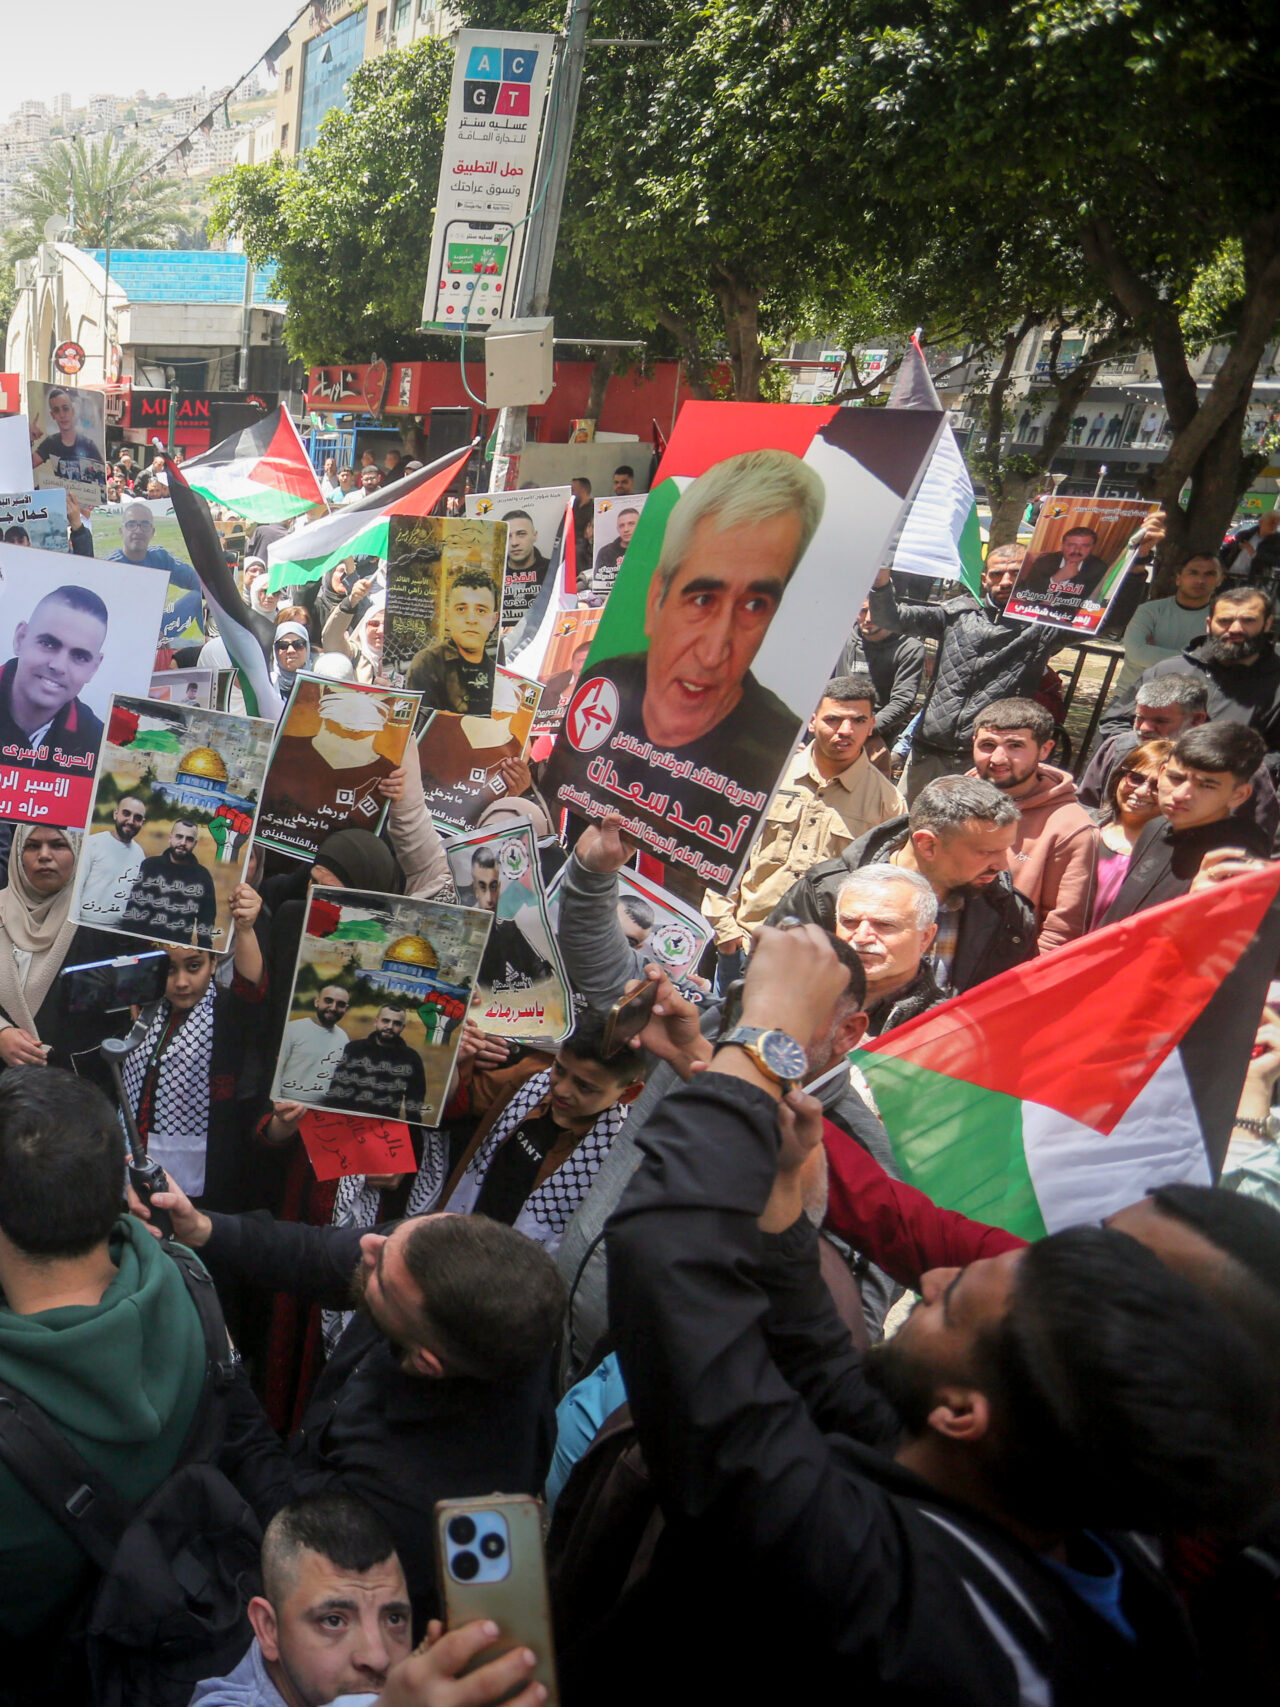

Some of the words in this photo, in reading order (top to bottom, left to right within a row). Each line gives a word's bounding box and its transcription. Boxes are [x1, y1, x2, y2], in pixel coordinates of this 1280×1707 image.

[477, 55, 490, 71] A
[512, 57, 525, 73] C
[473, 89, 486, 105] G
[508, 91, 519, 107] T
[452, 160, 498, 176] التطبيق
[500, 161, 524, 177] حمل
[485, 184, 521, 198] وتسوق
[141, 398, 211, 417] MIAN
[17, 507, 49, 523] كمال
[2, 742, 50, 761] لأسرى
[53, 747, 96, 771] الحرية
[610, 731, 653, 762] المناضل
[649, 748, 695, 778] الوطني
[23, 776, 70, 798] الأسير
[586, 755, 671, 816] سعدات
[690, 767, 728, 795] للقائد
[18, 797, 50, 818] مراد
[557, 783, 592, 809] فلسطين
[723, 780, 769, 812] الحرية
[666, 800, 752, 854] أحمد
[642, 825, 677, 856] للجبهة
[670, 845, 704, 871] العام
[697, 858, 734, 886] الأمين
[517, 1131, 542, 1161] GANT
